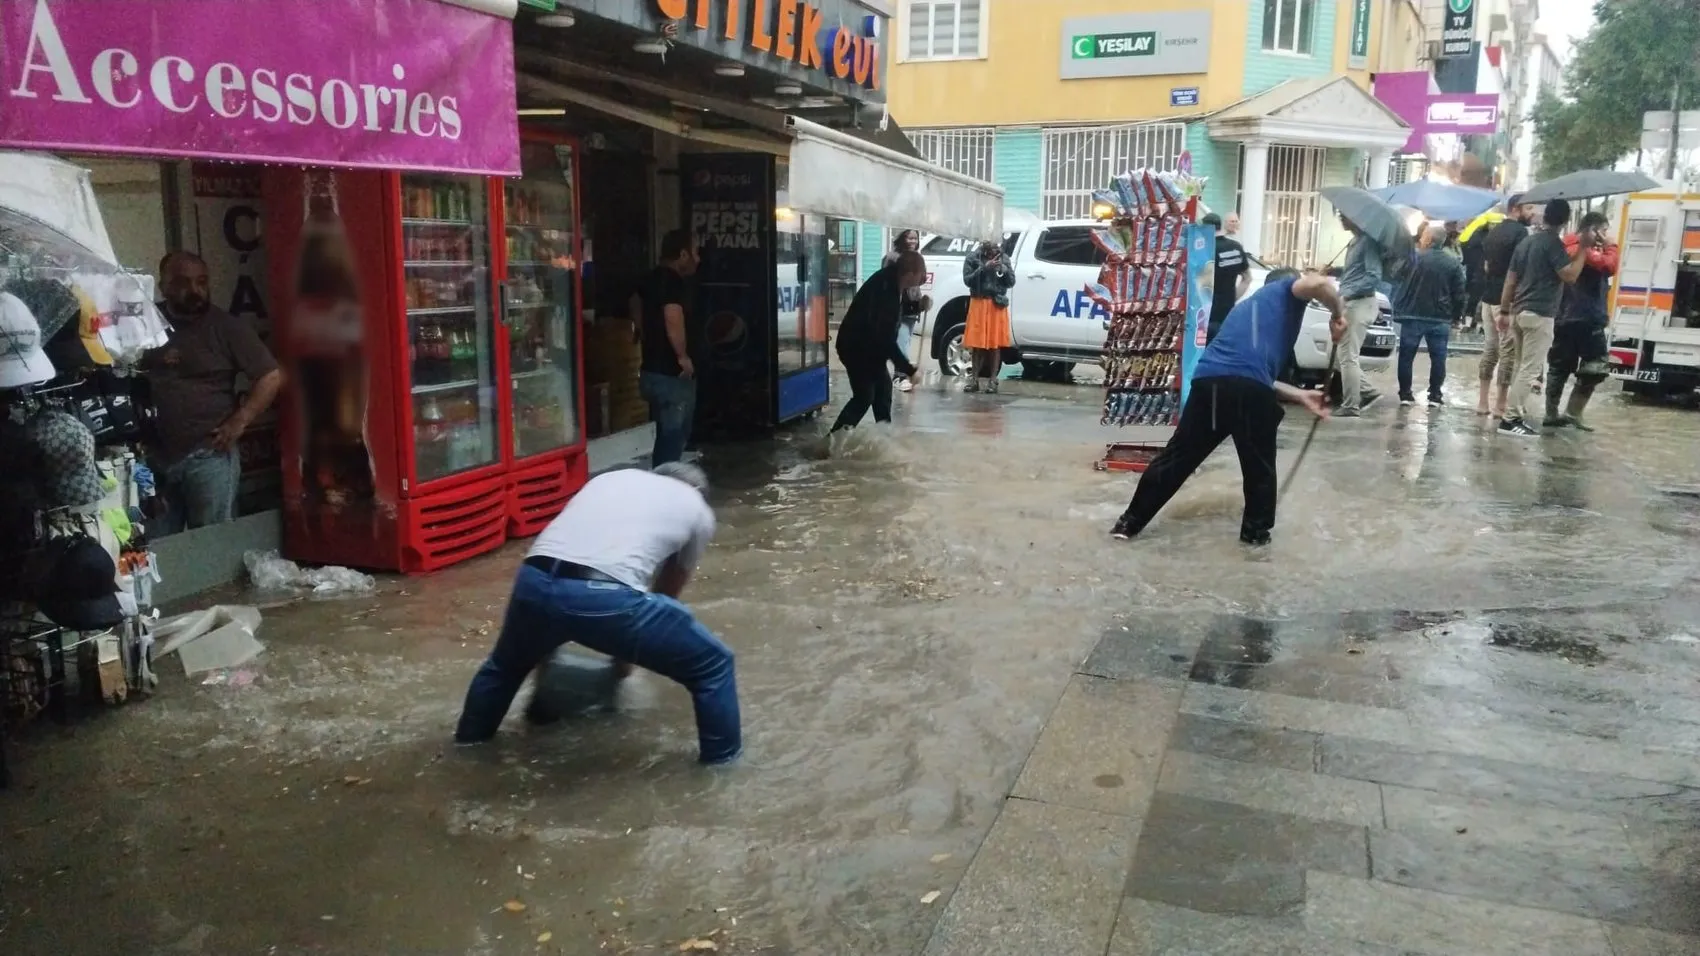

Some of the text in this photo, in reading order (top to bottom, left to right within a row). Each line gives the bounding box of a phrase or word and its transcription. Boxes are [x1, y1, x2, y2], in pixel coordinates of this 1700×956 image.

[10, 0, 463, 140] Accessories
[831, 15, 881, 91] evi
[715, 233, 760, 248] YANA
[1638, 370, 1658, 381] 773
